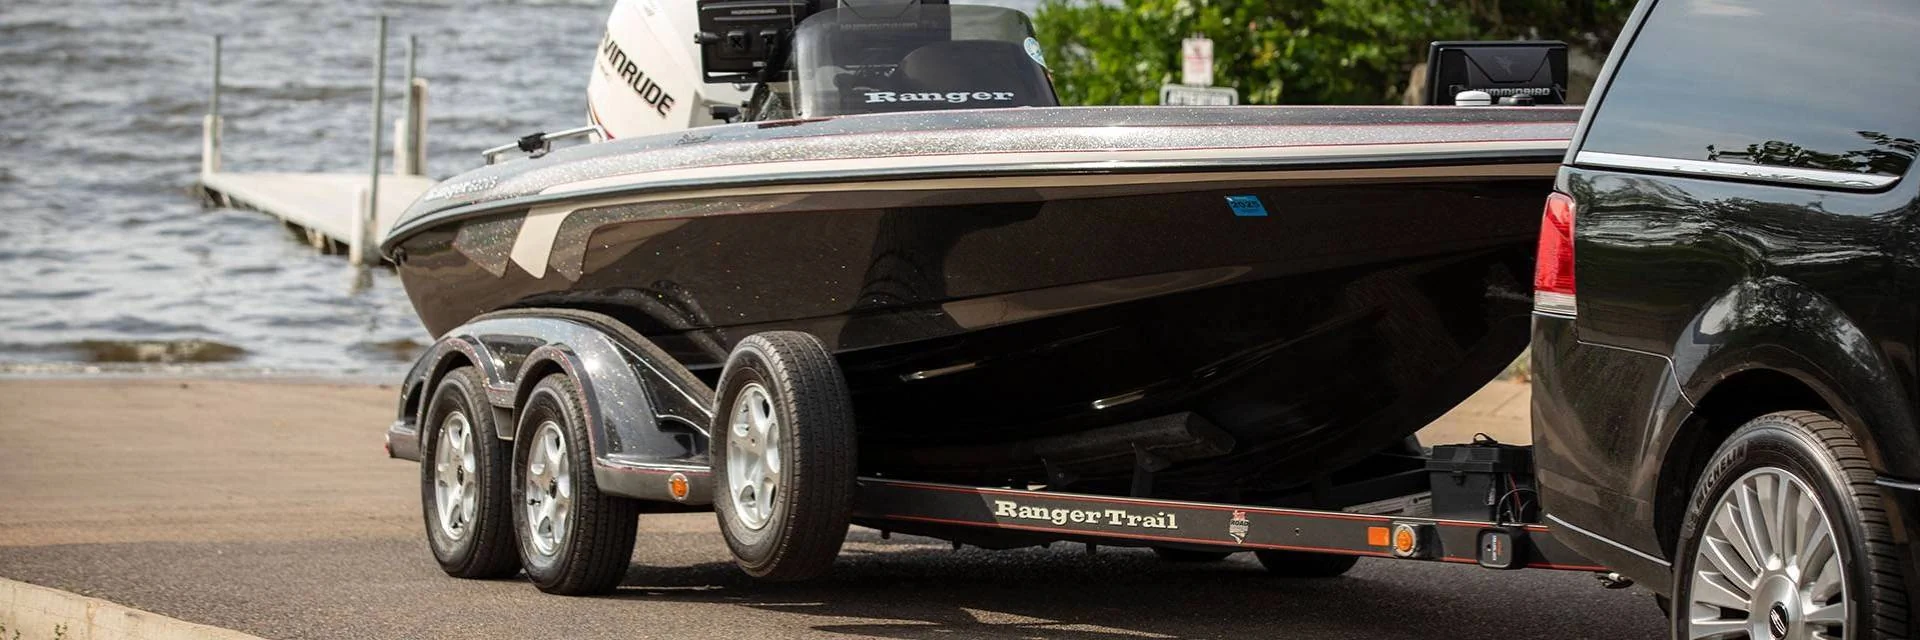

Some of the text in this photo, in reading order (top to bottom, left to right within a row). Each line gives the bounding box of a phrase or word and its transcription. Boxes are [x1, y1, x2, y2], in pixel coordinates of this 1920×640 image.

[603, 33, 675, 117] VINRUDE
[864, 91, 1014, 103] Ranger
[1473, 87, 1550, 96] MMINBIRD
[994, 500, 1178, 529] Ranger Trail
